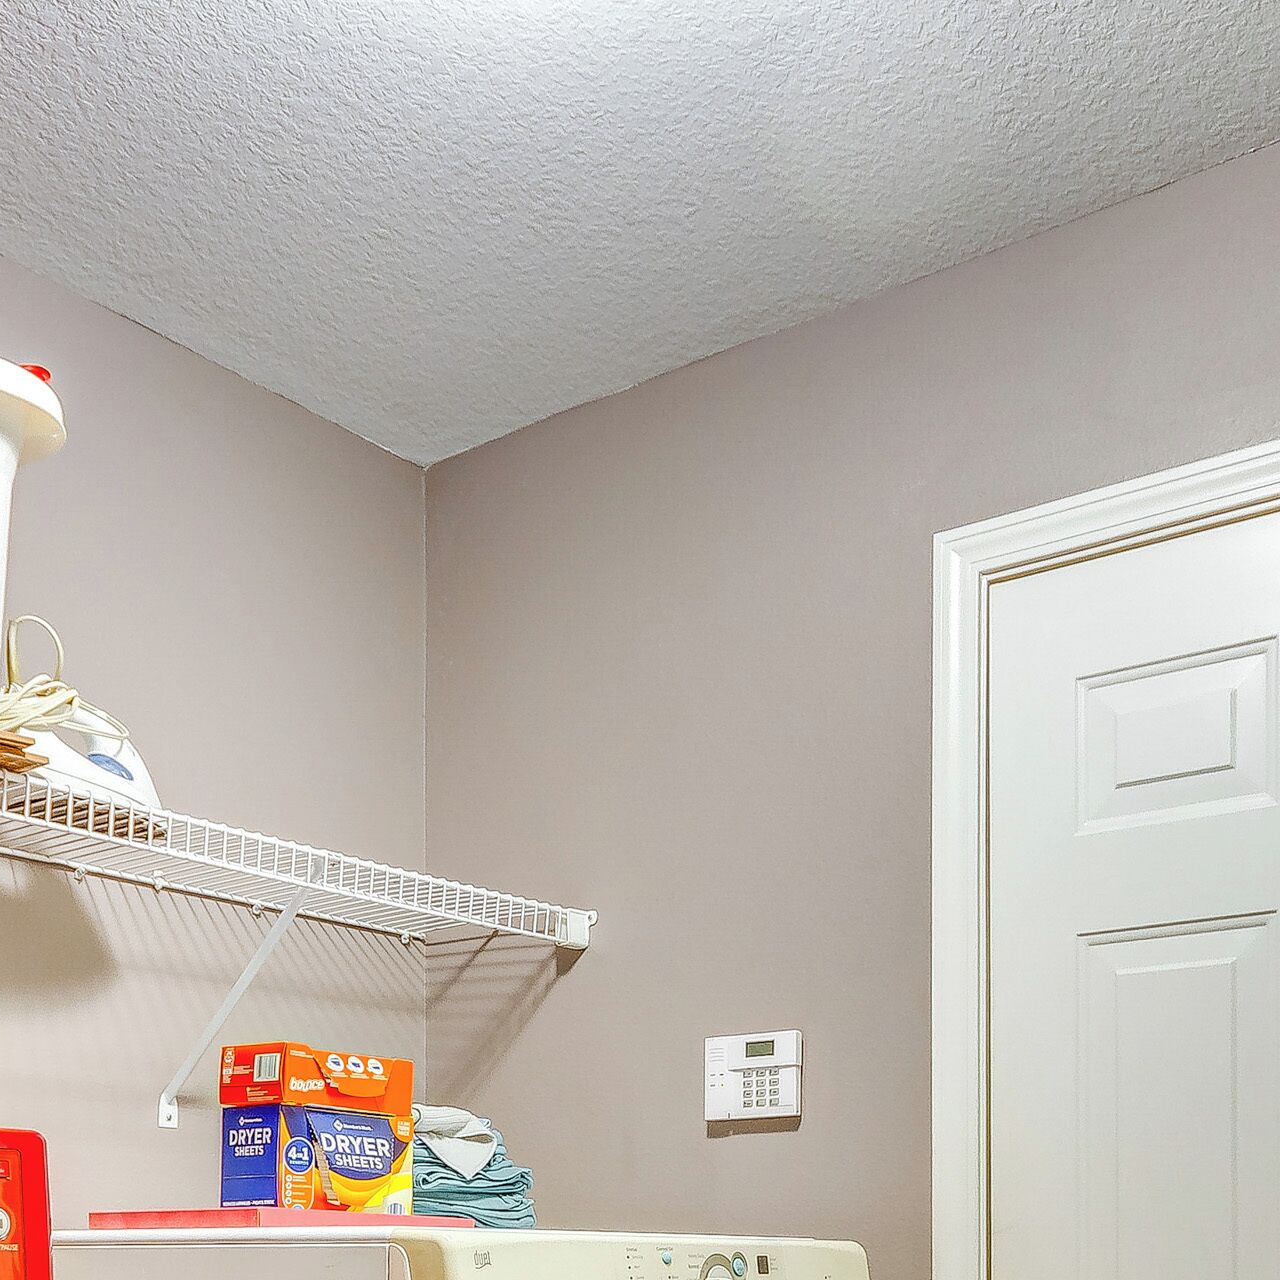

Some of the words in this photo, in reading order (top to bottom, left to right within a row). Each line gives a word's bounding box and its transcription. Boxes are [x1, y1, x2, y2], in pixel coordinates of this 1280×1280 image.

[229, 1127, 272, 1146] DRYER
[320, 1132, 392, 1157] DRYER
[234, 1145, 265, 1157] SHEETS
[334, 1153, 385, 1170] SHEETS
